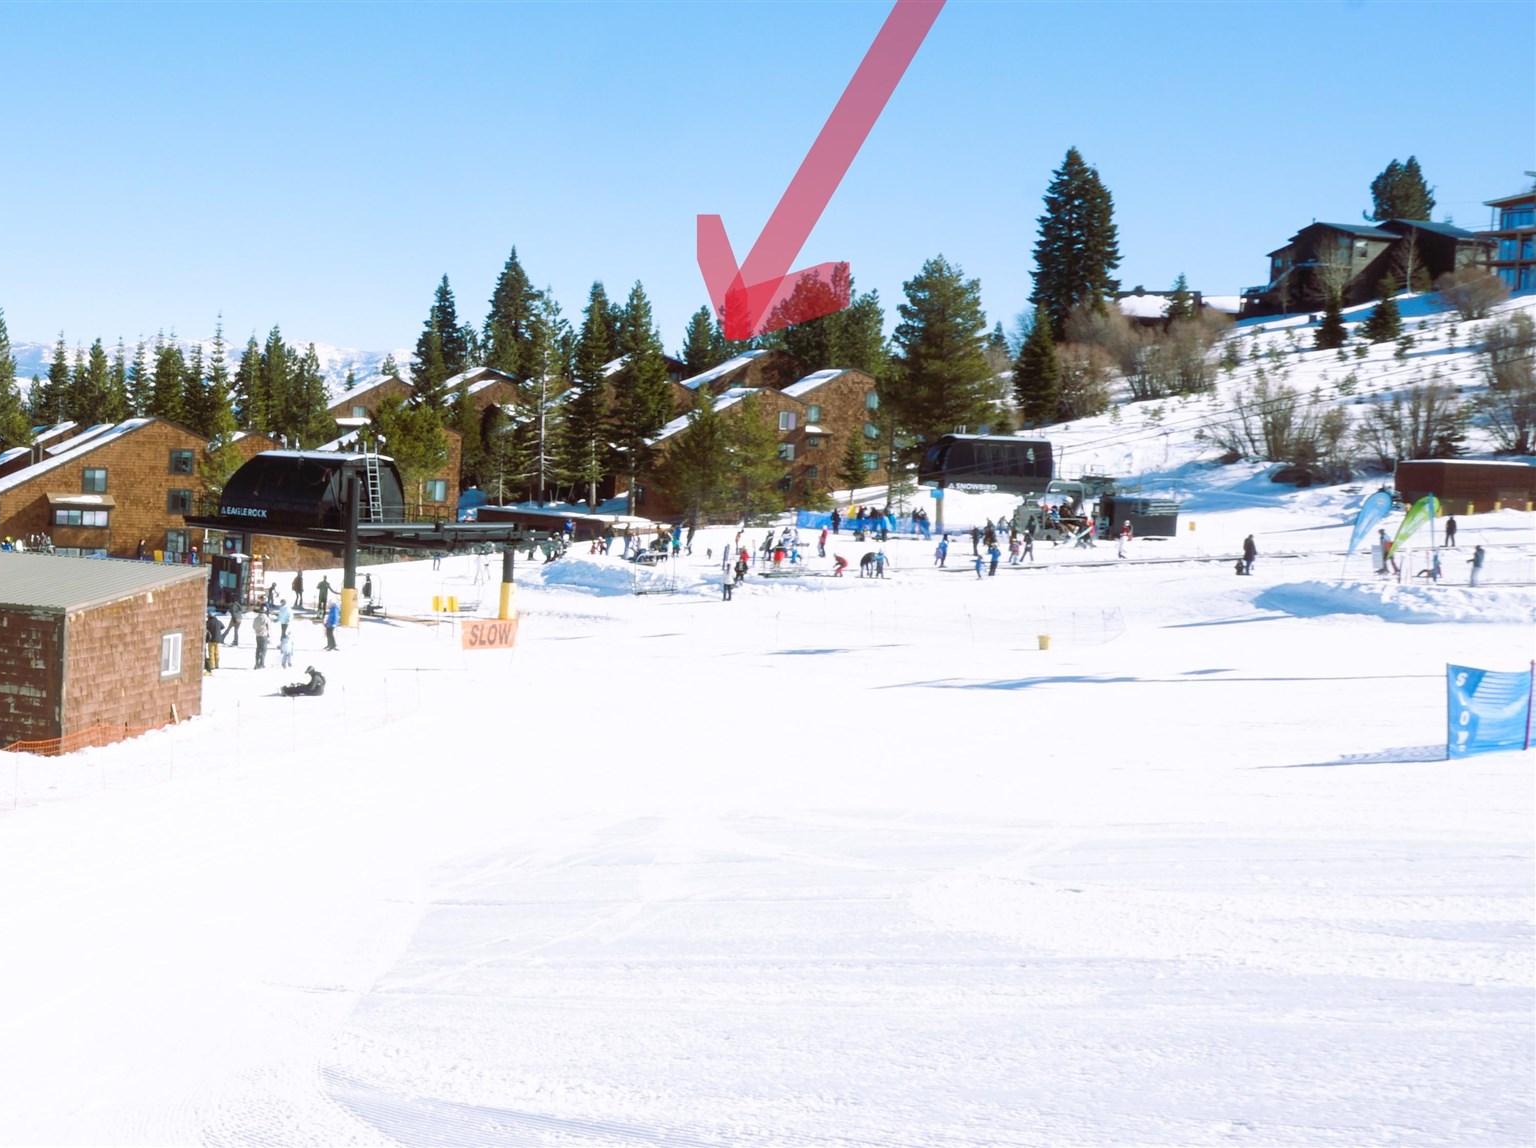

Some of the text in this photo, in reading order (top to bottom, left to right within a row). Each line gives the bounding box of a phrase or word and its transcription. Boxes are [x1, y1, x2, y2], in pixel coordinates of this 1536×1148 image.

[955, 482, 998, 491] SNOWBIRD
[226, 506, 267, 518] EAGLE ROCK
[469, 623, 512, 646] SLOW
